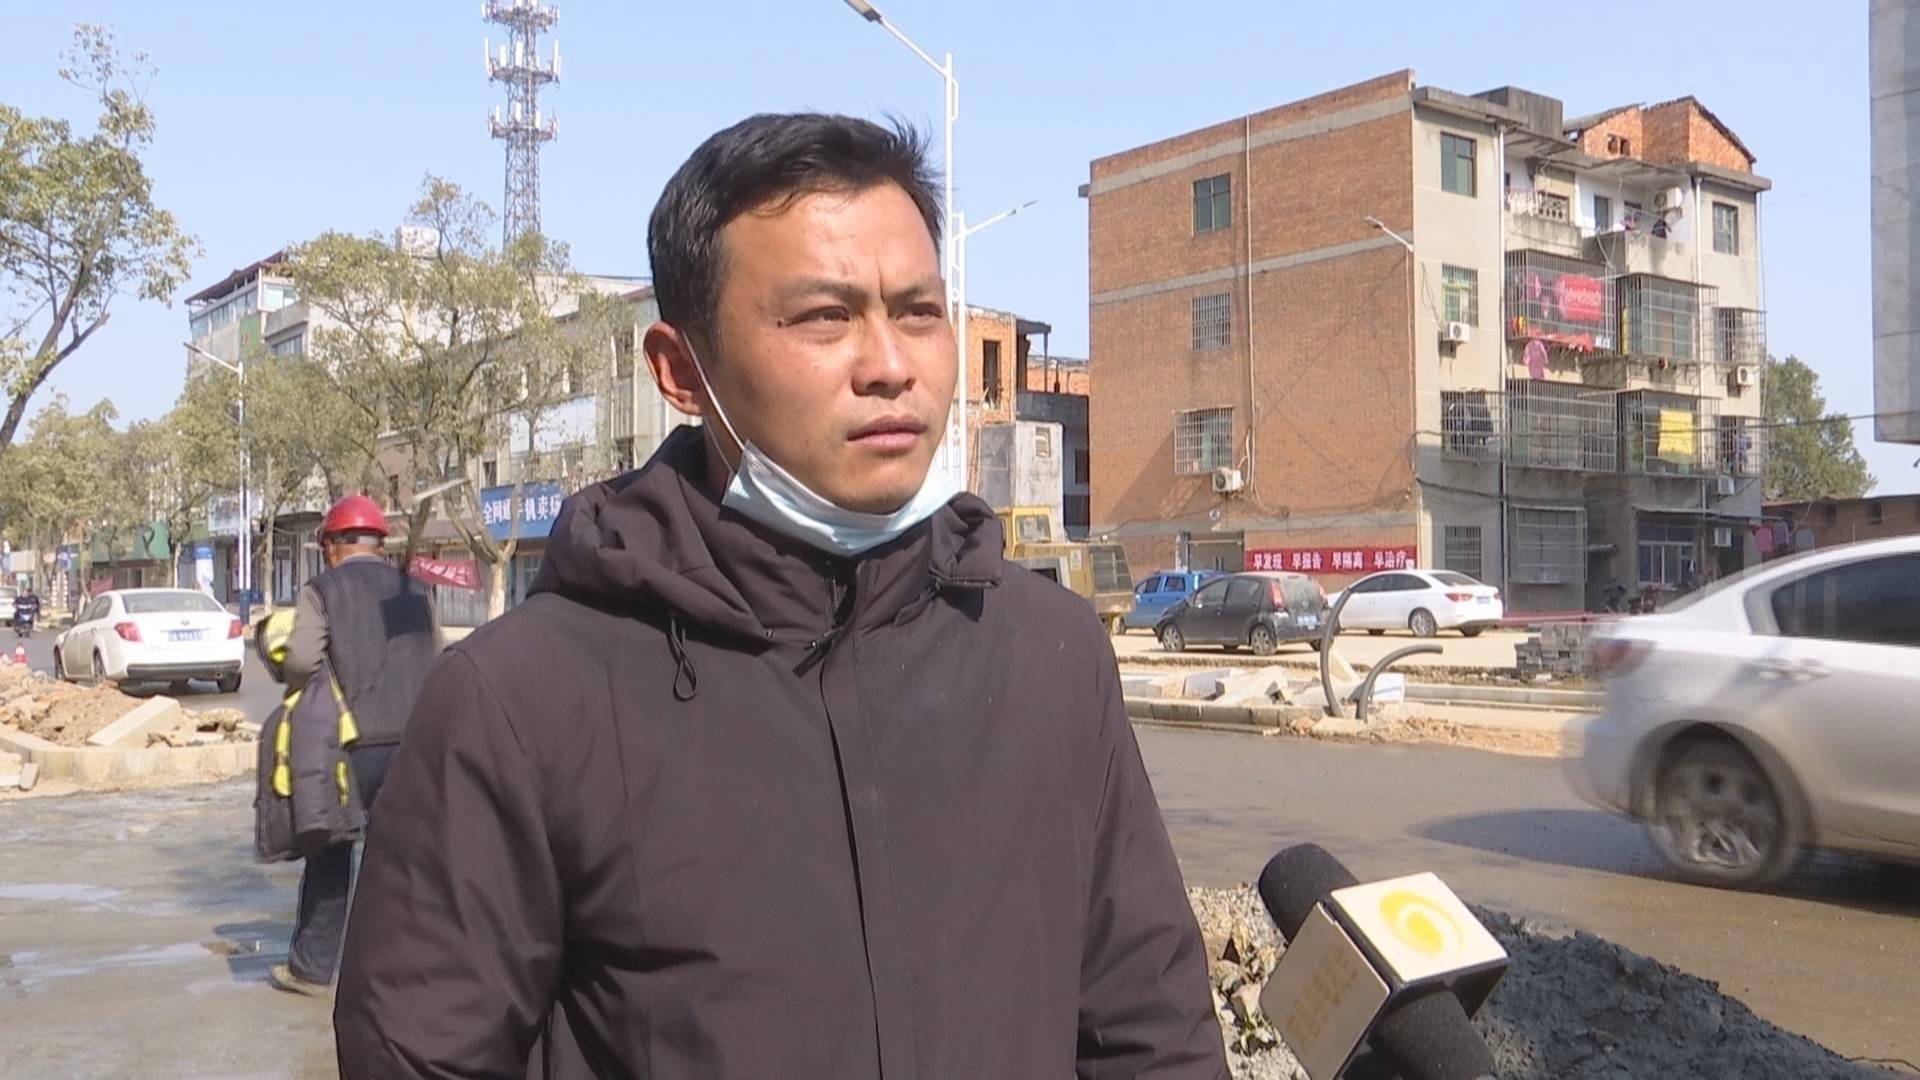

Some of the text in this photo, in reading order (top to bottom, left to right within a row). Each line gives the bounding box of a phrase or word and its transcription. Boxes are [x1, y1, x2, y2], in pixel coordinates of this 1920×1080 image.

[1253, 553, 1282, 570] 早发现
[1292, 551, 1322, 570] 早报告
[1332, 551, 1363, 569] 早隔离
[1374, 550, 1406, 568] 早治疗
